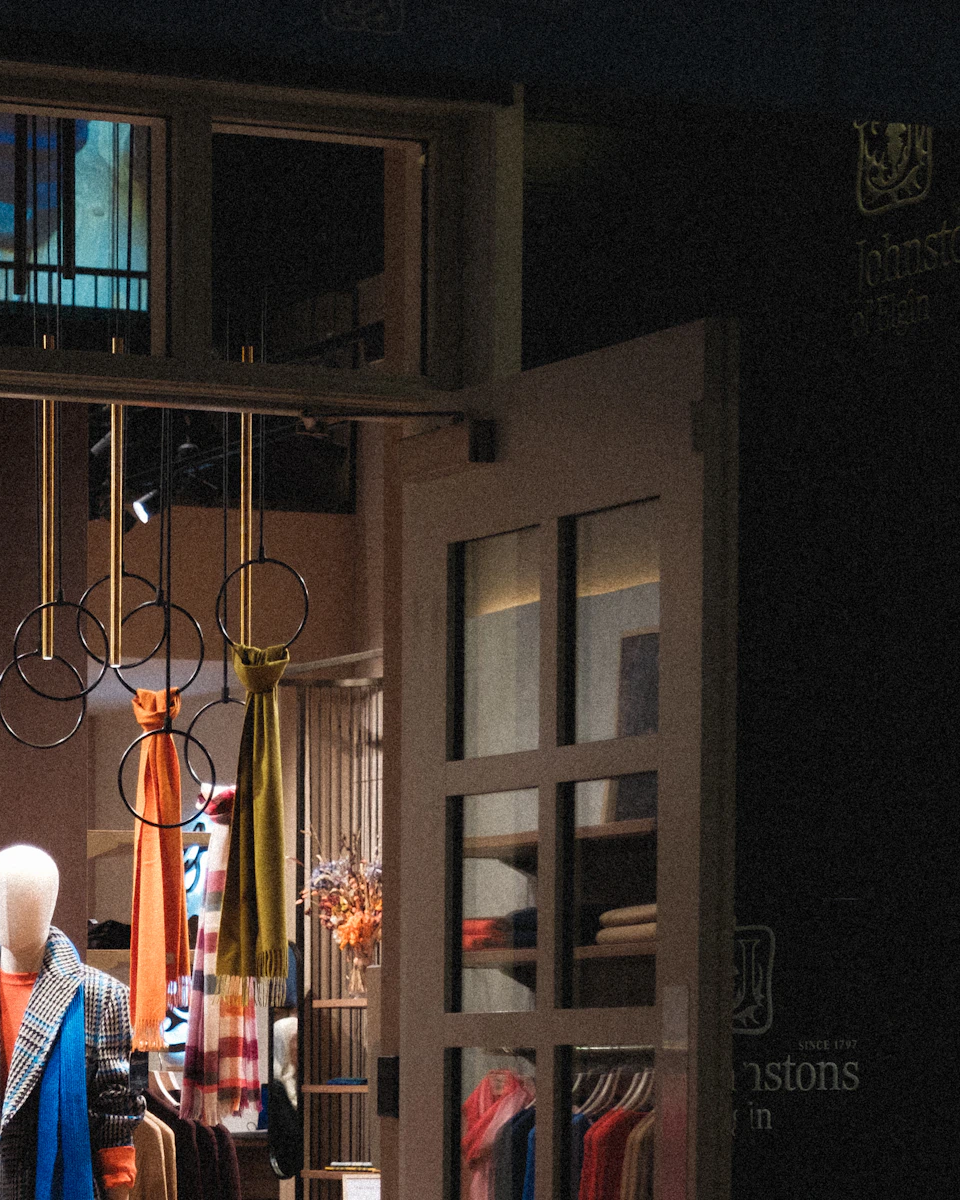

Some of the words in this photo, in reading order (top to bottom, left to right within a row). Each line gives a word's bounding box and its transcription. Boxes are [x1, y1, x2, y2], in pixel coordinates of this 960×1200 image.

[798, 1039, 830, 1051] SINCE
[833, 1039, 858, 1051] 1797
[733, 1054, 861, 1092] nstons
